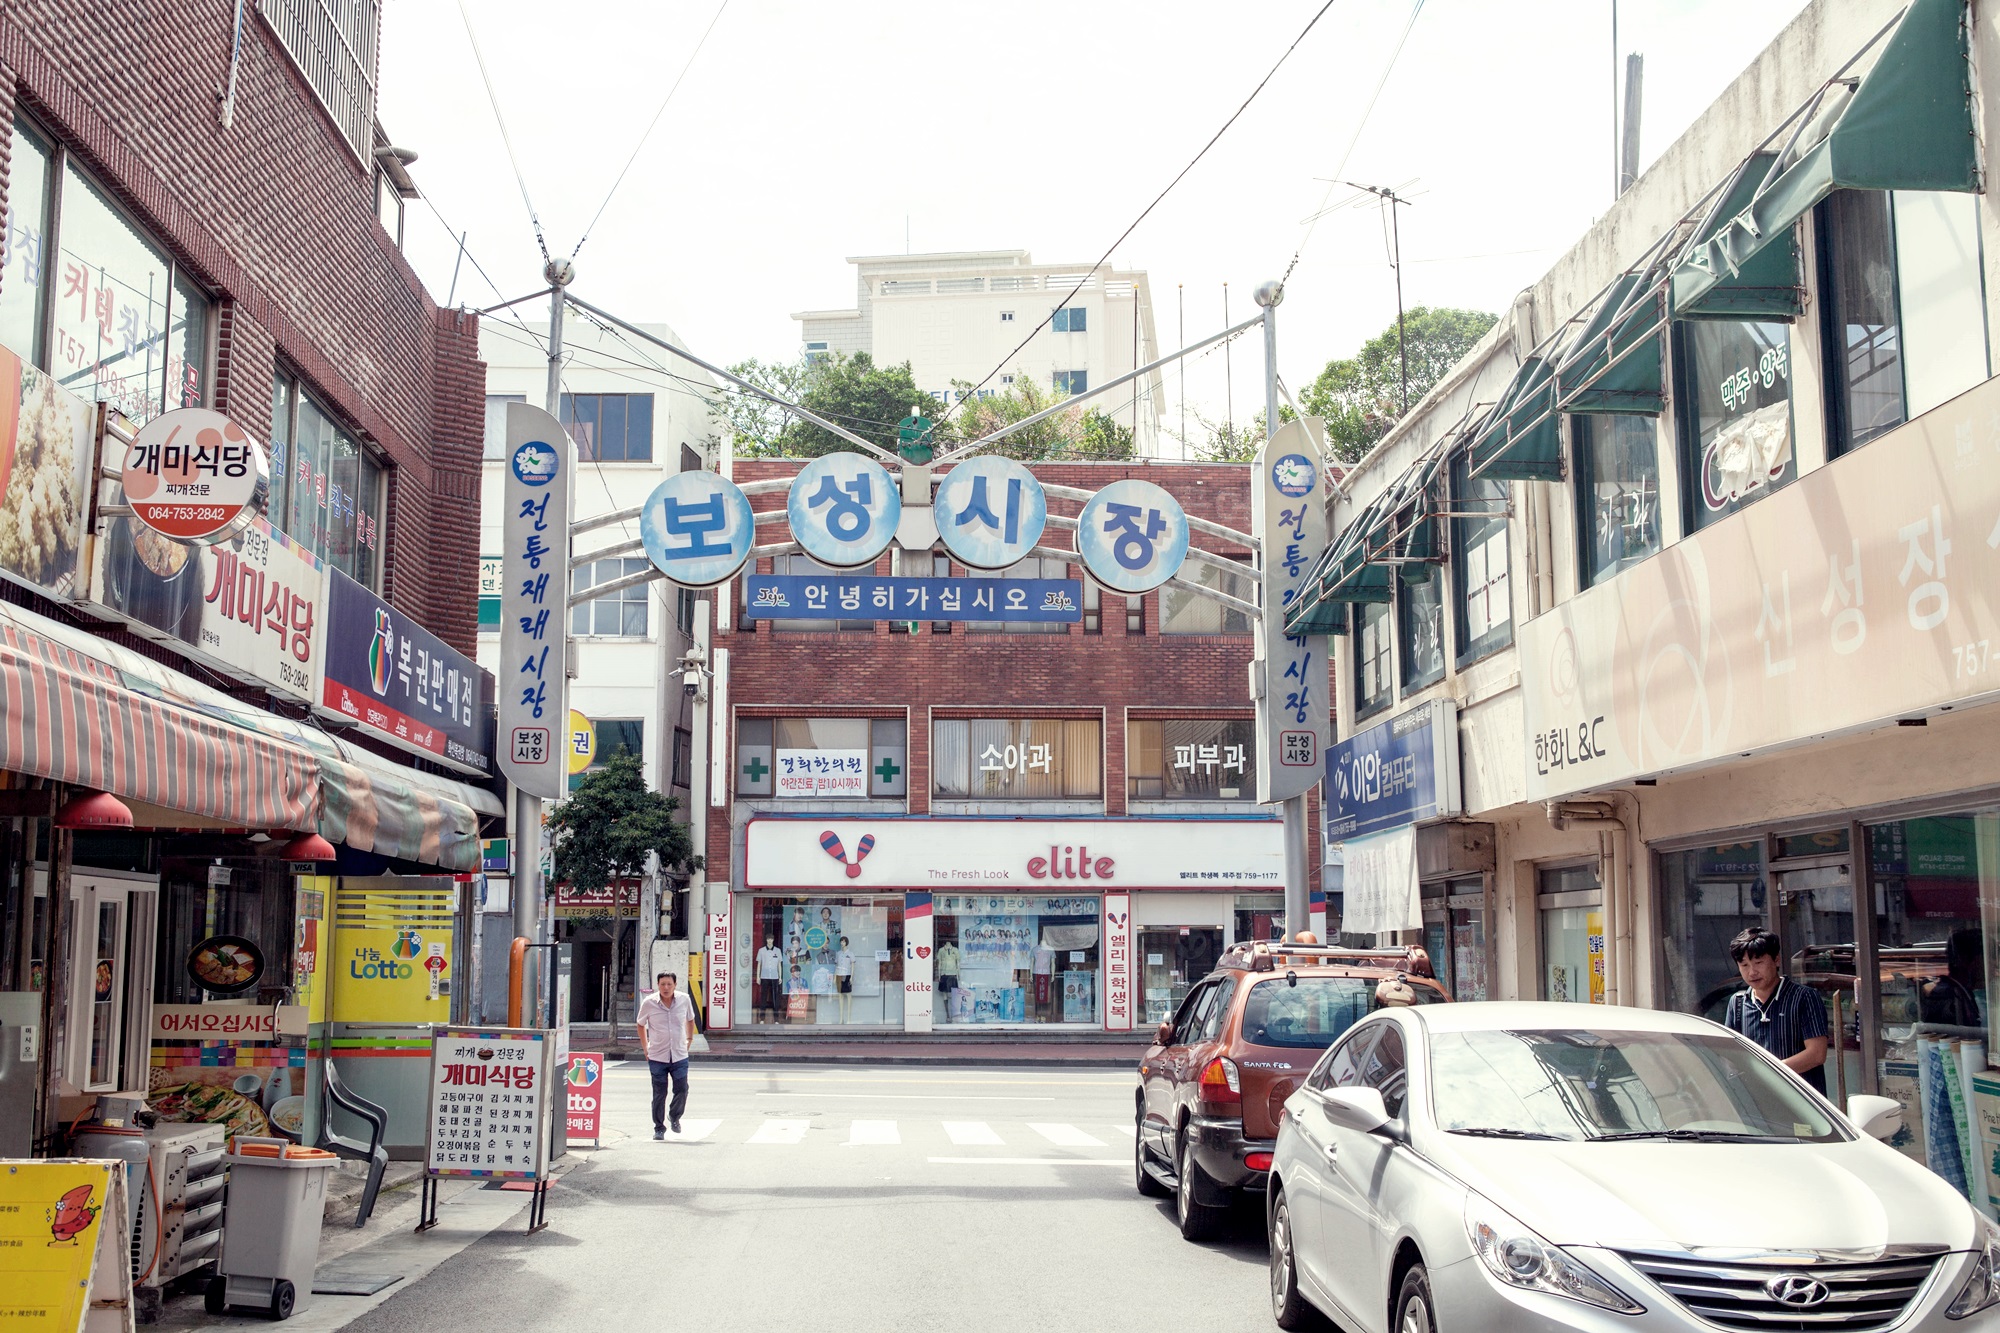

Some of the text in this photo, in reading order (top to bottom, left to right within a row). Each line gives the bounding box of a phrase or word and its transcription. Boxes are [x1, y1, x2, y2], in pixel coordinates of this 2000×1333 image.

[132, 444, 252, 477] 개미식당
[165, 484, 211, 496] 찌개전문
[148, 506, 225, 520] 064-753-2842
[246, 528, 269, 566] 전문점
[205, 545, 314, 663] 개미식당
[757, 587, 786, 607] Jeju
[1045, 591, 1073, 611] Jeju
[519, 491, 550, 719] 전통재래시장
[1278, 503, 1309, 724] 전통시장
[280, 661, 309, 692] 753-2842
[398, 636, 473, 728] 복권판매점
[518, 732, 542, 745] 보성
[573, 732, 589, 754] 권
[1286, 735, 1310, 748] 보성
[1535, 715, 1606, 776] 한화L&C
[517, 746, 543, 760] 시장
[979, 743, 1053, 775] 소아과
[1174, 743, 1247, 775] 피부과
[1286, 749, 1311, 763] 시장
[781, 756, 862, 774] 경희한의원
[781, 777, 862, 790] 야간진료 밤10시까지
[1352, 750, 1417, 804] 이안 컴퓨터
[294, 863, 313, 872] VISA
[1027, 845, 1115, 879] elite
[928, 869, 1009, 879] The Fresh Look
[1221, 872, 1242, 880] 제주점
[1244, 872, 1278, 880] 759-1177
[622, 907, 639, 917] 3F
[355, 947, 381, 962] 나눔
[351, 959, 413, 980] Lotto
[905, 981, 932, 992] elite
[160, 1013, 281, 1032] 어서오십시오
[454, 1046, 525, 1060] 찌개 전문점
[1244, 1061, 1271, 1069] SANTA
[440, 1063, 536, 1089] 개미식당
[440, 1092, 484, 1103] 고등어구이
[490, 1094, 534, 1105] 김치찌개
[439, 1104, 483, 1115] 해물파전
[489, 1109, 533, 1119] 된장찌개
[438, 1116, 482, 1127] 동태전골
[438, 1129, 482, 1139] 두부김치
[488, 1124, 532, 1134] 참치찌개
[436, 1140, 481, 1151] 오징어볶음
[436, 1153, 481, 1164] 닭도리탕
